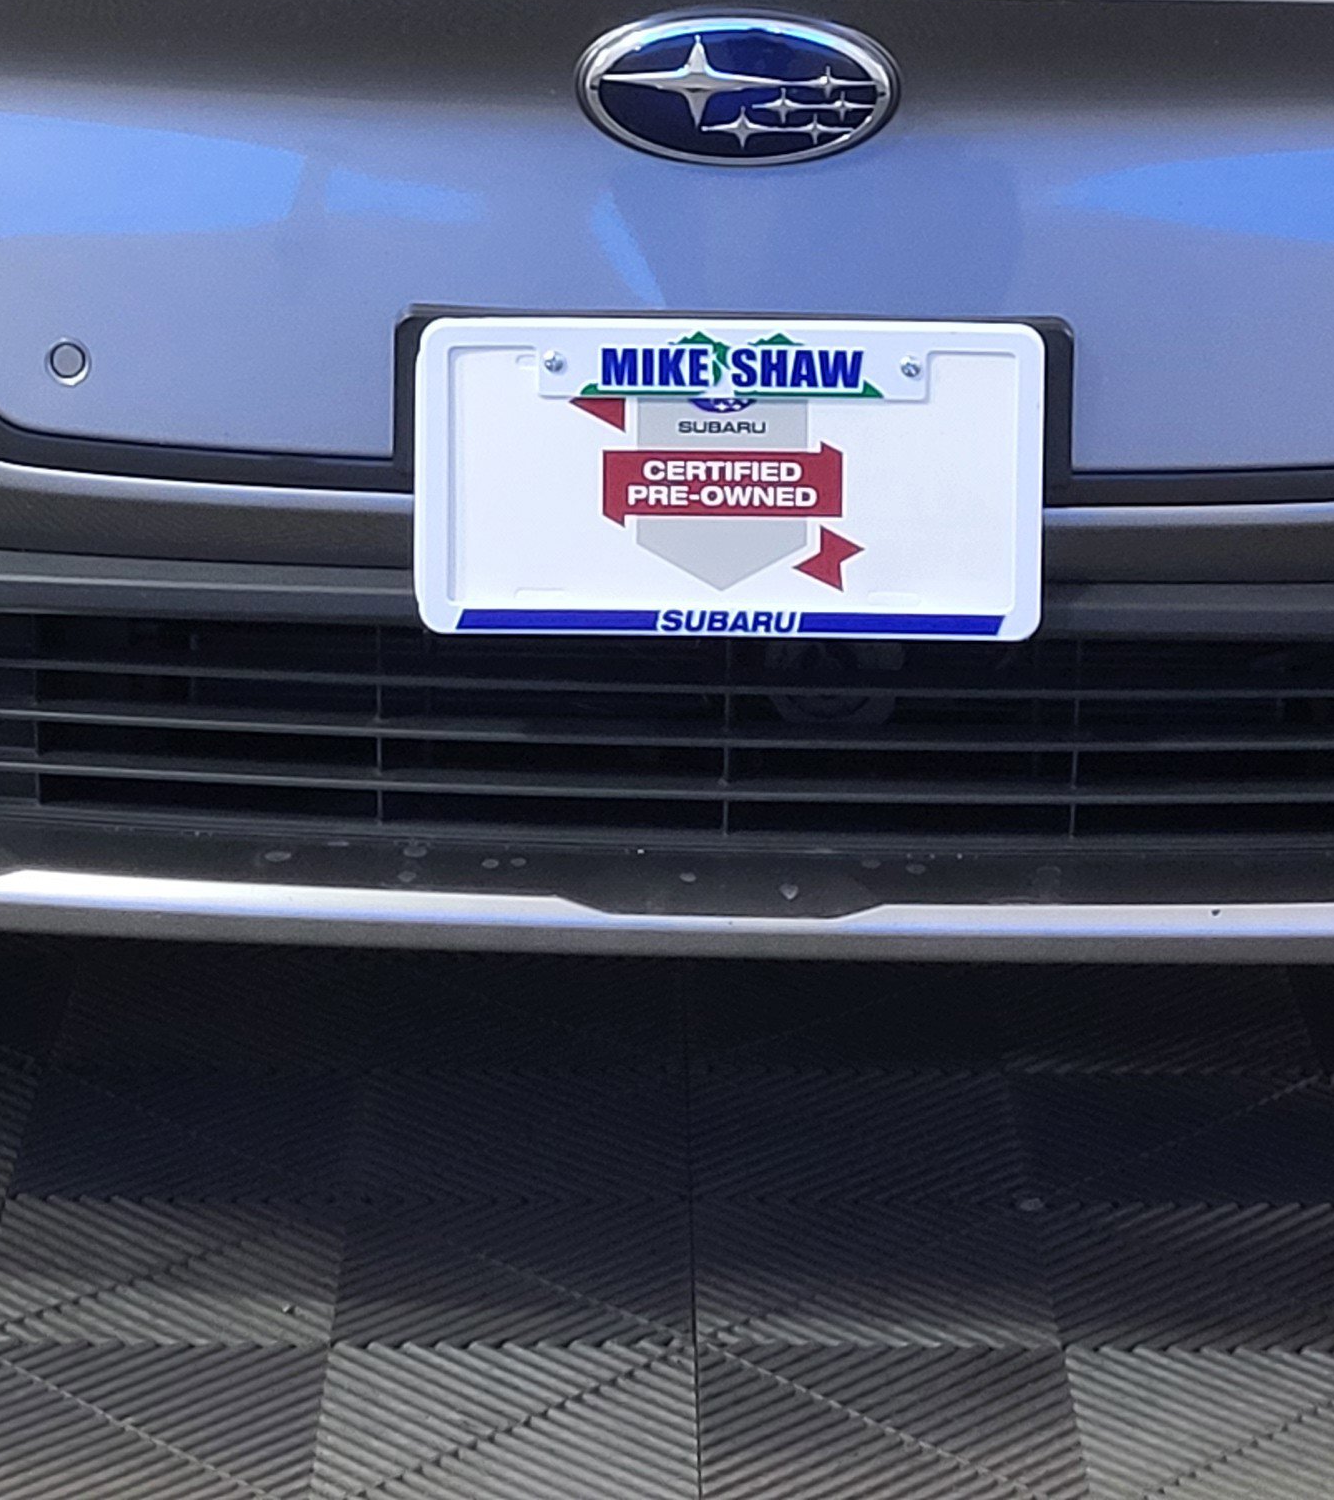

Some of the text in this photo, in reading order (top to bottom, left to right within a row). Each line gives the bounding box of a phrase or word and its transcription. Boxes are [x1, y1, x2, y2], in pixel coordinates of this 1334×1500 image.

[601, 348, 863, 388] MIKE SHAW
[677, 421, 767, 434] SUBARU
[642, 460, 803, 483] CERTIFIED
[627, 486, 818, 508] PRE-OWNED
[661, 609, 798, 633] SUBARU
